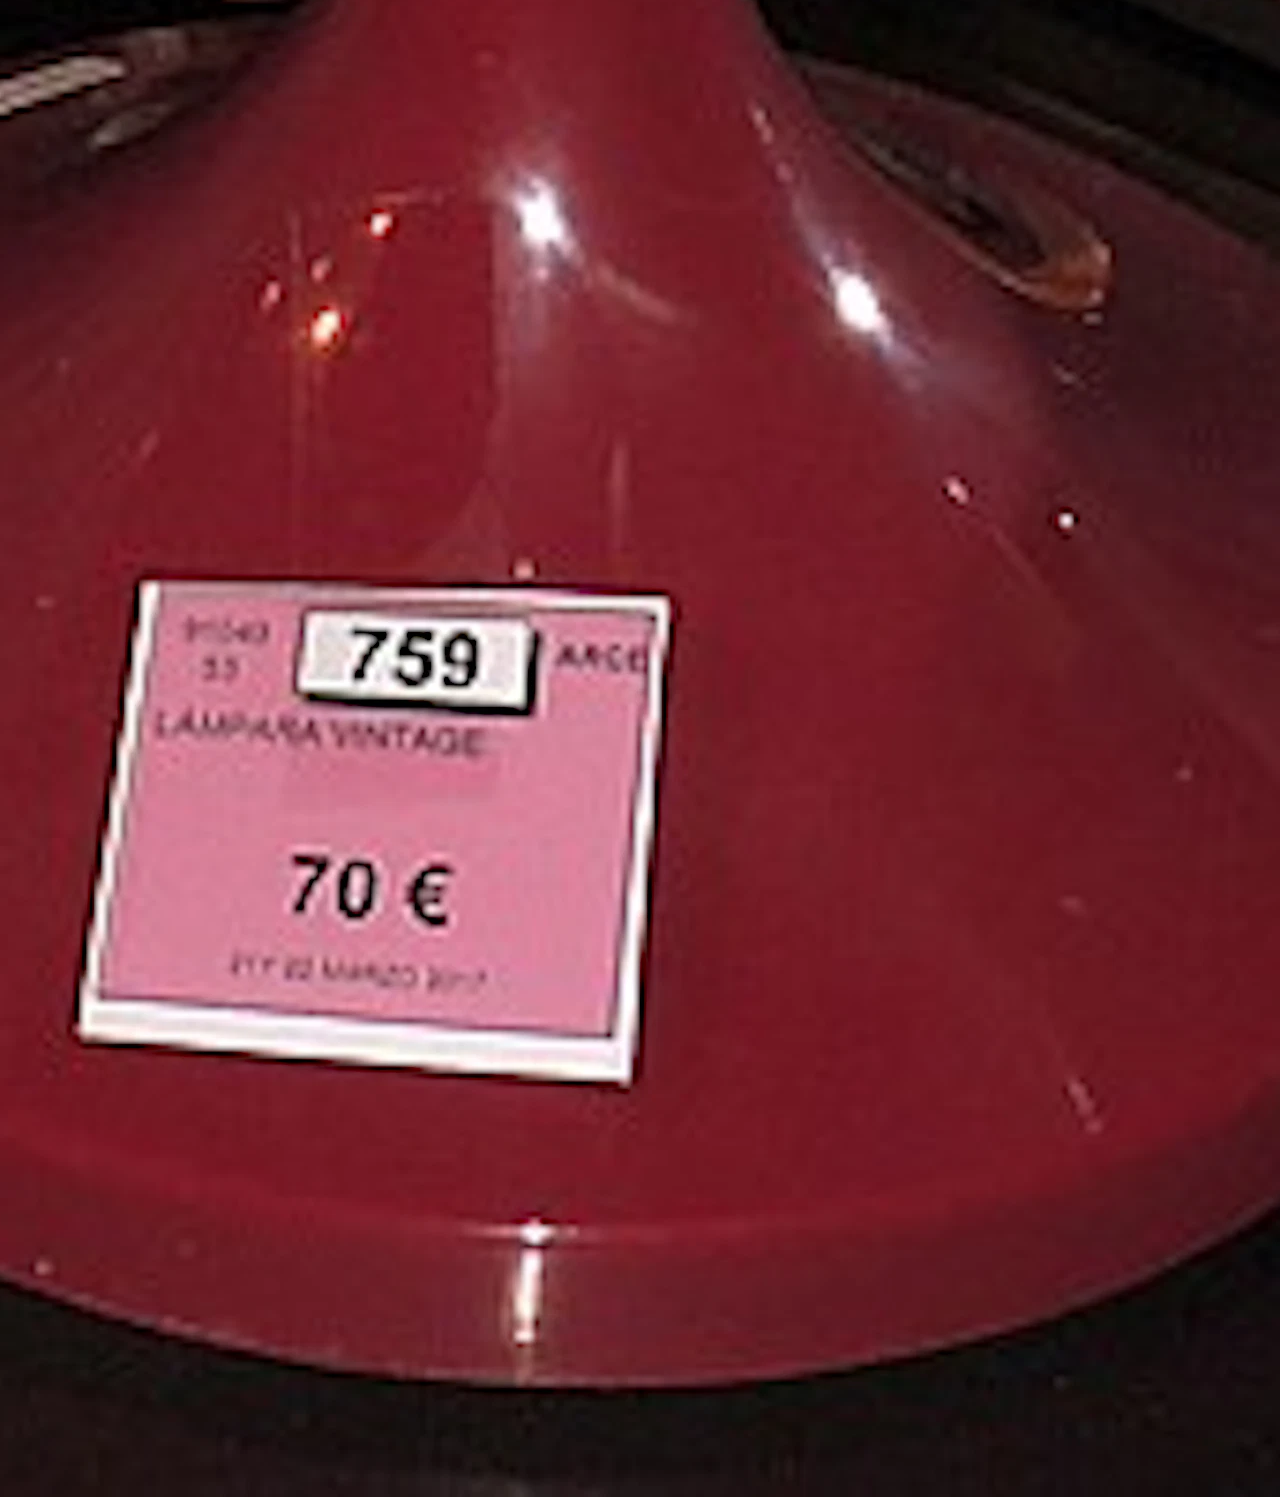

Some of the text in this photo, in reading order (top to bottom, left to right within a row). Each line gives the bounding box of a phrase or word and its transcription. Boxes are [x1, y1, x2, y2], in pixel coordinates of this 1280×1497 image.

[350, 628, 479, 687] 759
[326, 719, 487, 757] VINTAGE
[291, 853, 454, 927] 70 €
